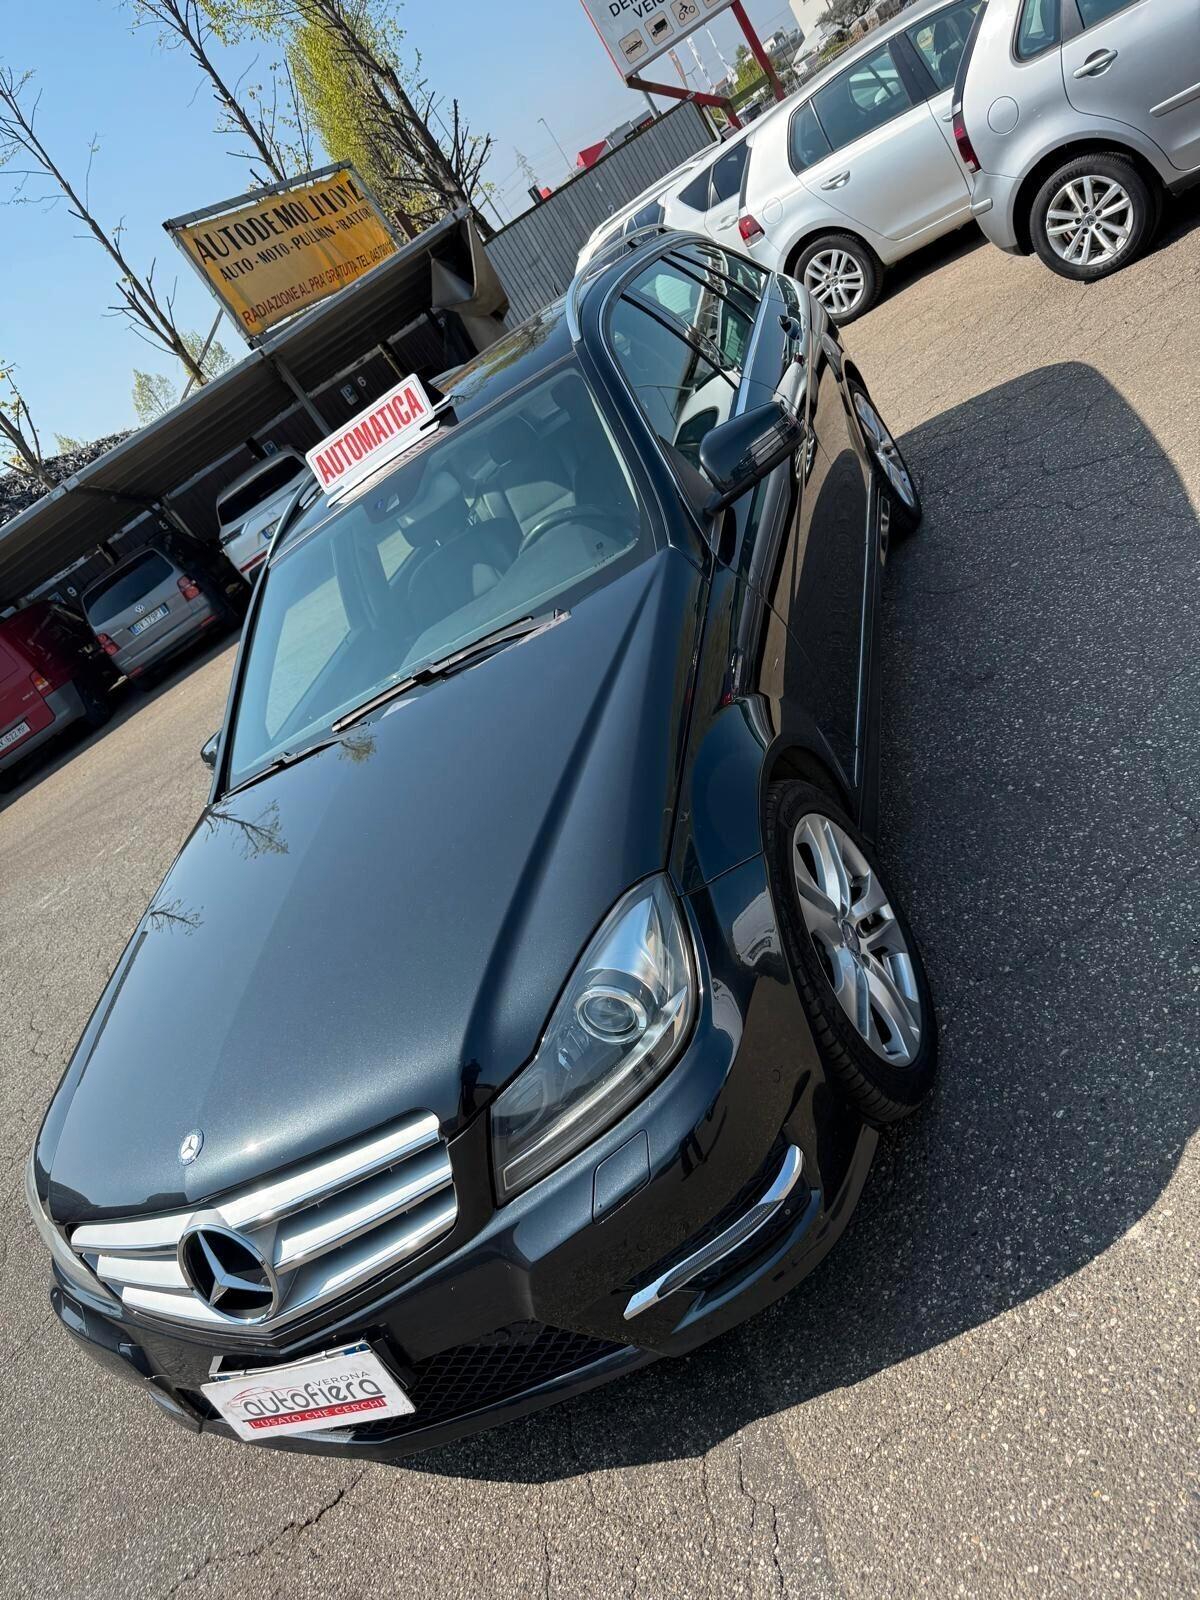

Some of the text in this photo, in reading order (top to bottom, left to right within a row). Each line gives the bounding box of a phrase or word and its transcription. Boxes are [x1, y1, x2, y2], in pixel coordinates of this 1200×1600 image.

[219, 257, 254, 282] AUTO
[257, 242, 290, 264] MOTO
[241, 285, 301, 326] RADIAZIONE
[297, 281, 312, 300] AL
[325, 261, 360, 287] GRATUITA
[357, 376, 367, 387] 6
[315, 387, 425, 484] AUTOMATICA
[242, 1378, 384, 1417] autofiera
[312, 1369, 371, 1388] VERONA
[249, 1398, 385, 1430] L'USATO CHE CERCHI
